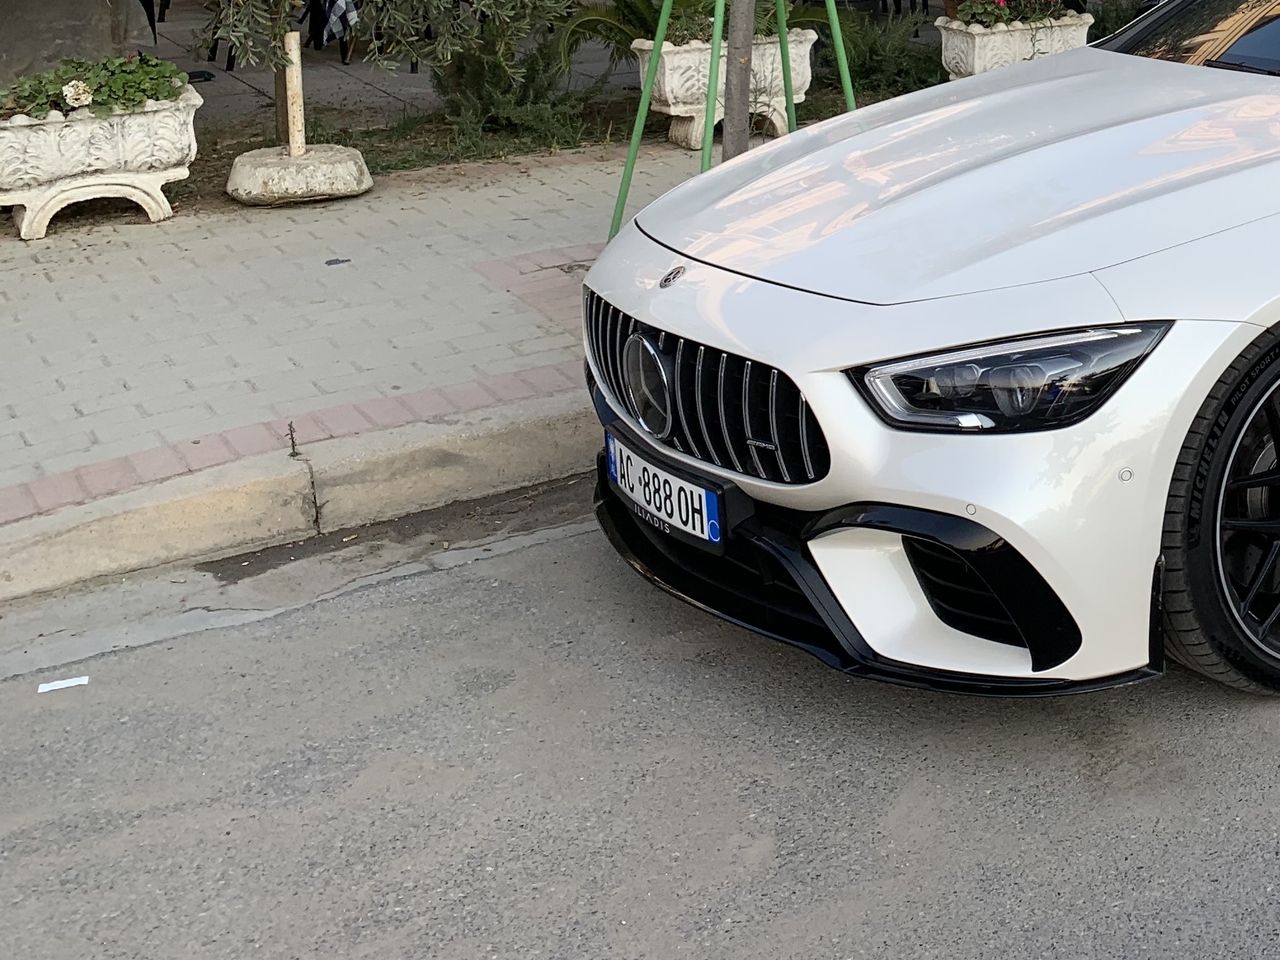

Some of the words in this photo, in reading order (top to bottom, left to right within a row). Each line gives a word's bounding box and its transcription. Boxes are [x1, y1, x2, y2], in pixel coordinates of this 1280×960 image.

[1231, 378, 1249, 405] PILOT
[1250, 351, 1275, 378] SPORT
[620, 448, 635, 493] AC
[642, 467, 674, 519] 888
[678, 486, 704, 535] OH
[1190, 410, 1229, 519] MICHELIN
